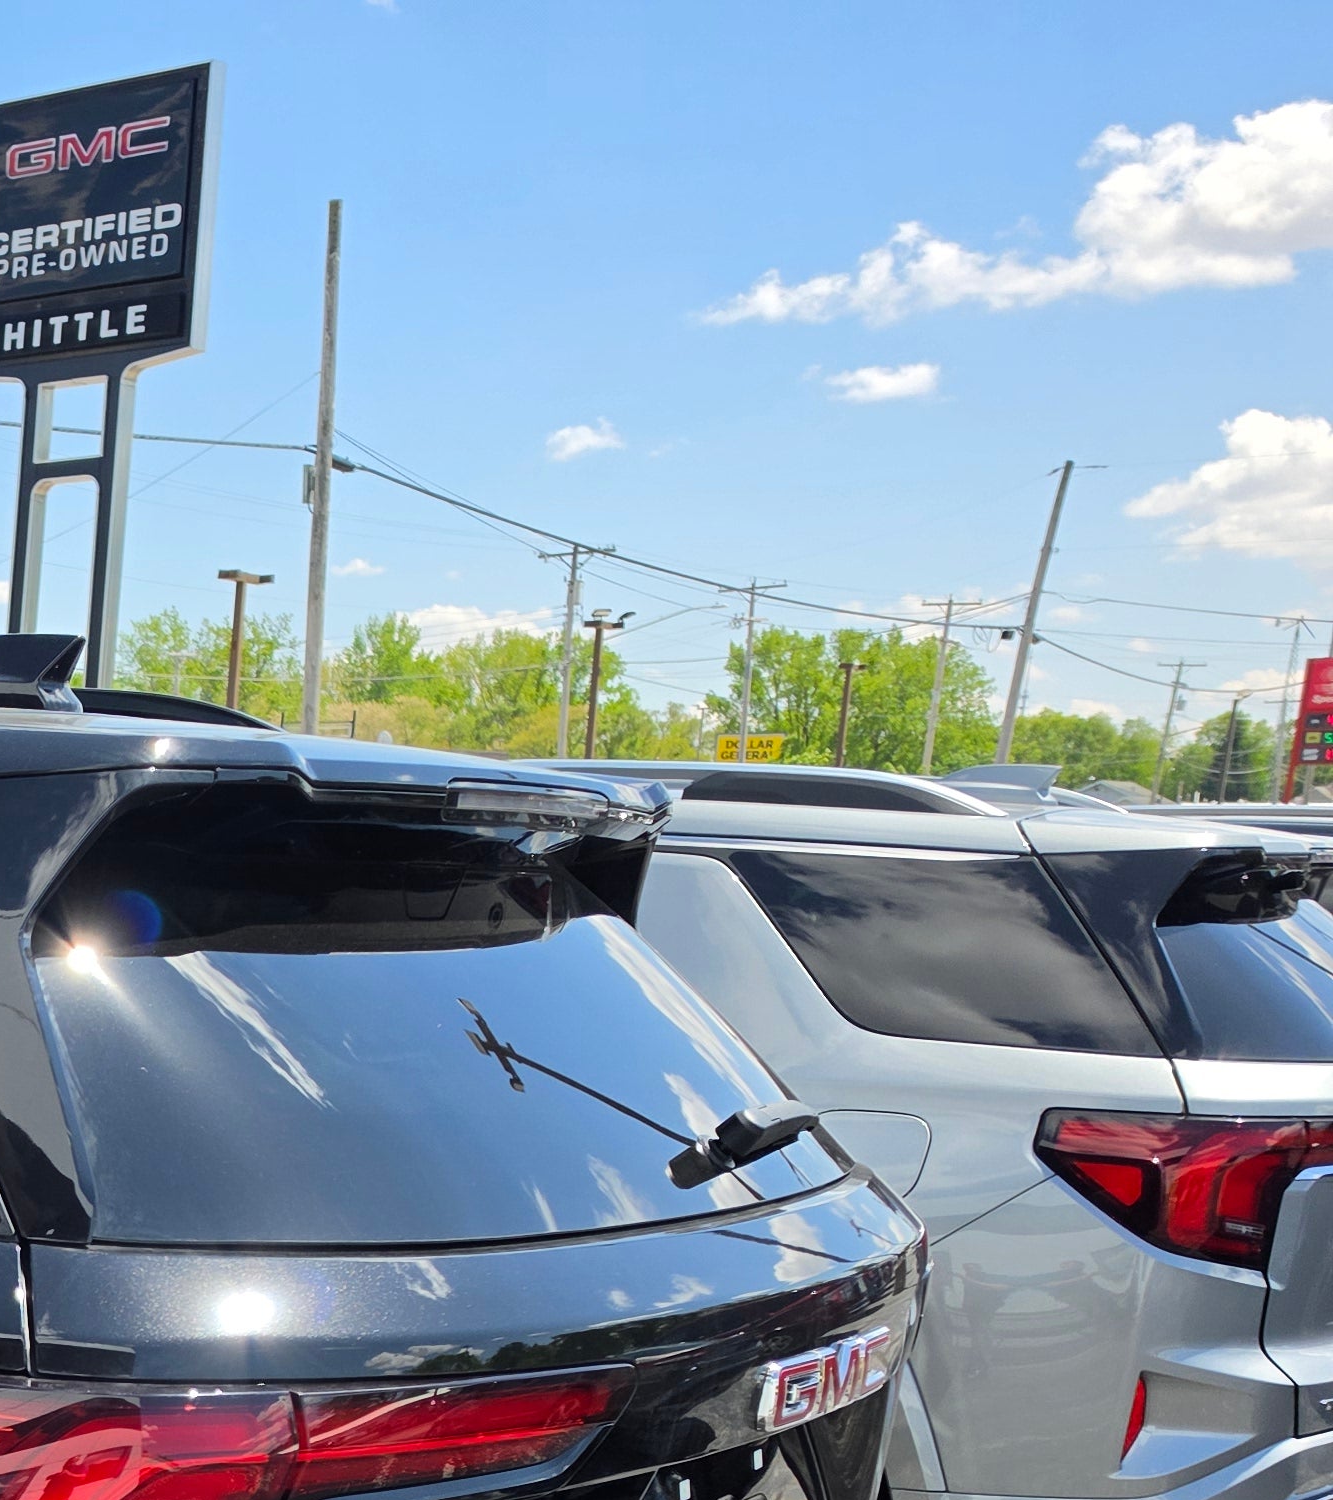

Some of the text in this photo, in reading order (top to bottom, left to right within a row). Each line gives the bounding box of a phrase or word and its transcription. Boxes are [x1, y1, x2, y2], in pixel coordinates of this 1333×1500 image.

[5, 115, 171, 179] GMC
[3, 304, 147, 351] HITTLE
[721, 750, 774, 760] GEERA
[726, 740, 774, 749] DOLAR
[757, 1326, 890, 1432] GMC
